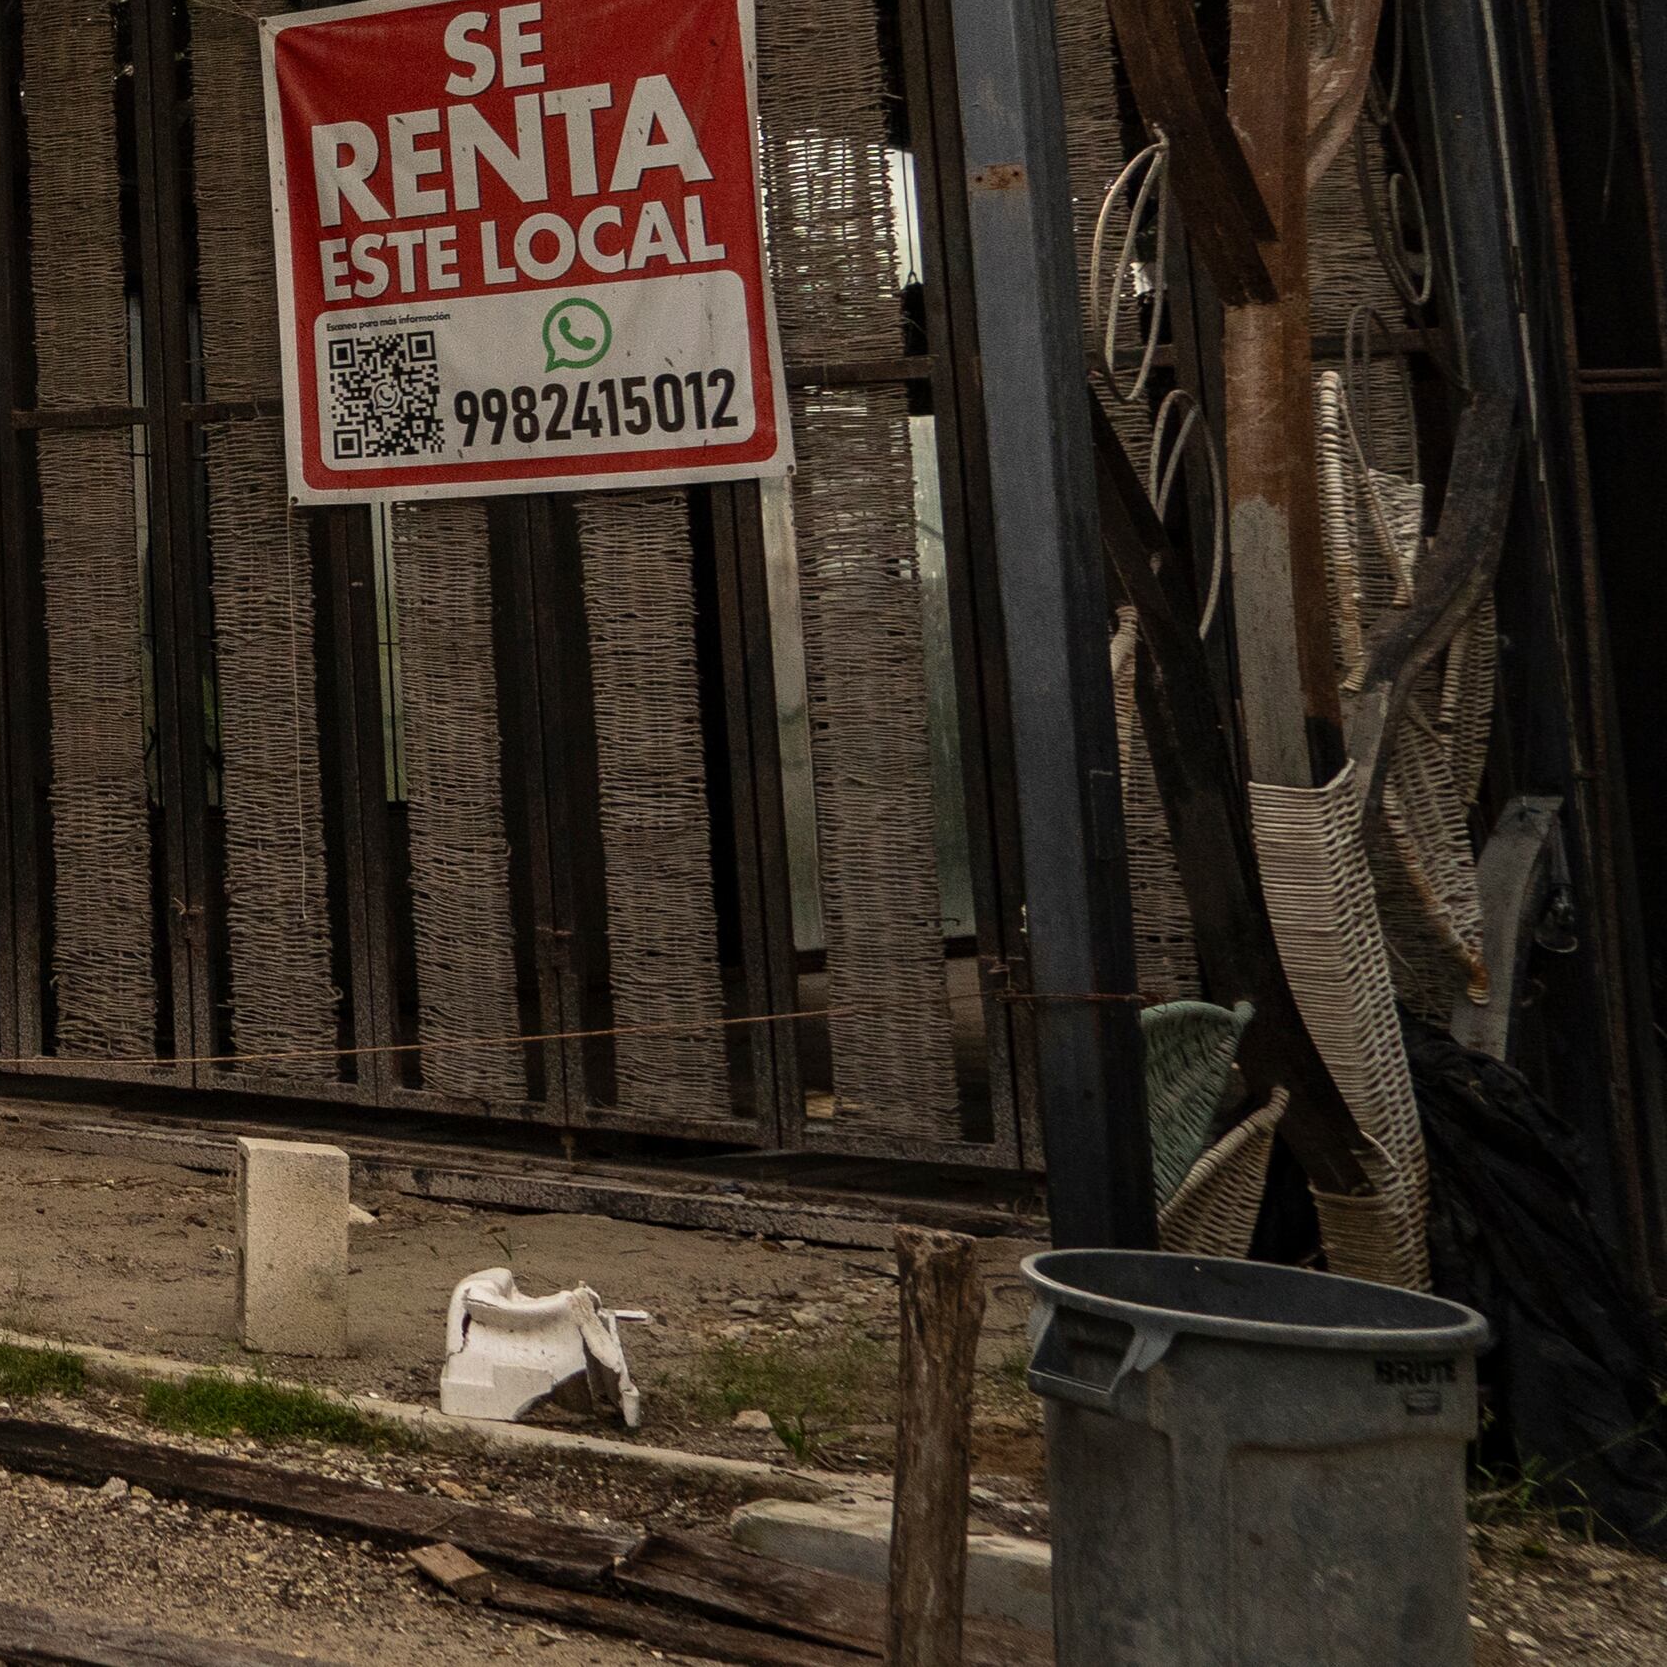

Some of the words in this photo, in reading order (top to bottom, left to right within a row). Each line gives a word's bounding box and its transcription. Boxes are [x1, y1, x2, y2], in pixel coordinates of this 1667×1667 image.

[443, 1, 546, 97] SE
[310, 73, 714, 228] RENTA
[321, 224, 462, 302] ESTE
[479, 194, 726, 286] LOCAL
[326, 322, 357, 332] Escanea
[358, 320, 379, 331] para
[379, 315, 397, 326] más
[398, 311, 451, 324] información
[453, 368, 740, 447] 9982415012
[1374, 1358, 1457, 1384] BRUTE
